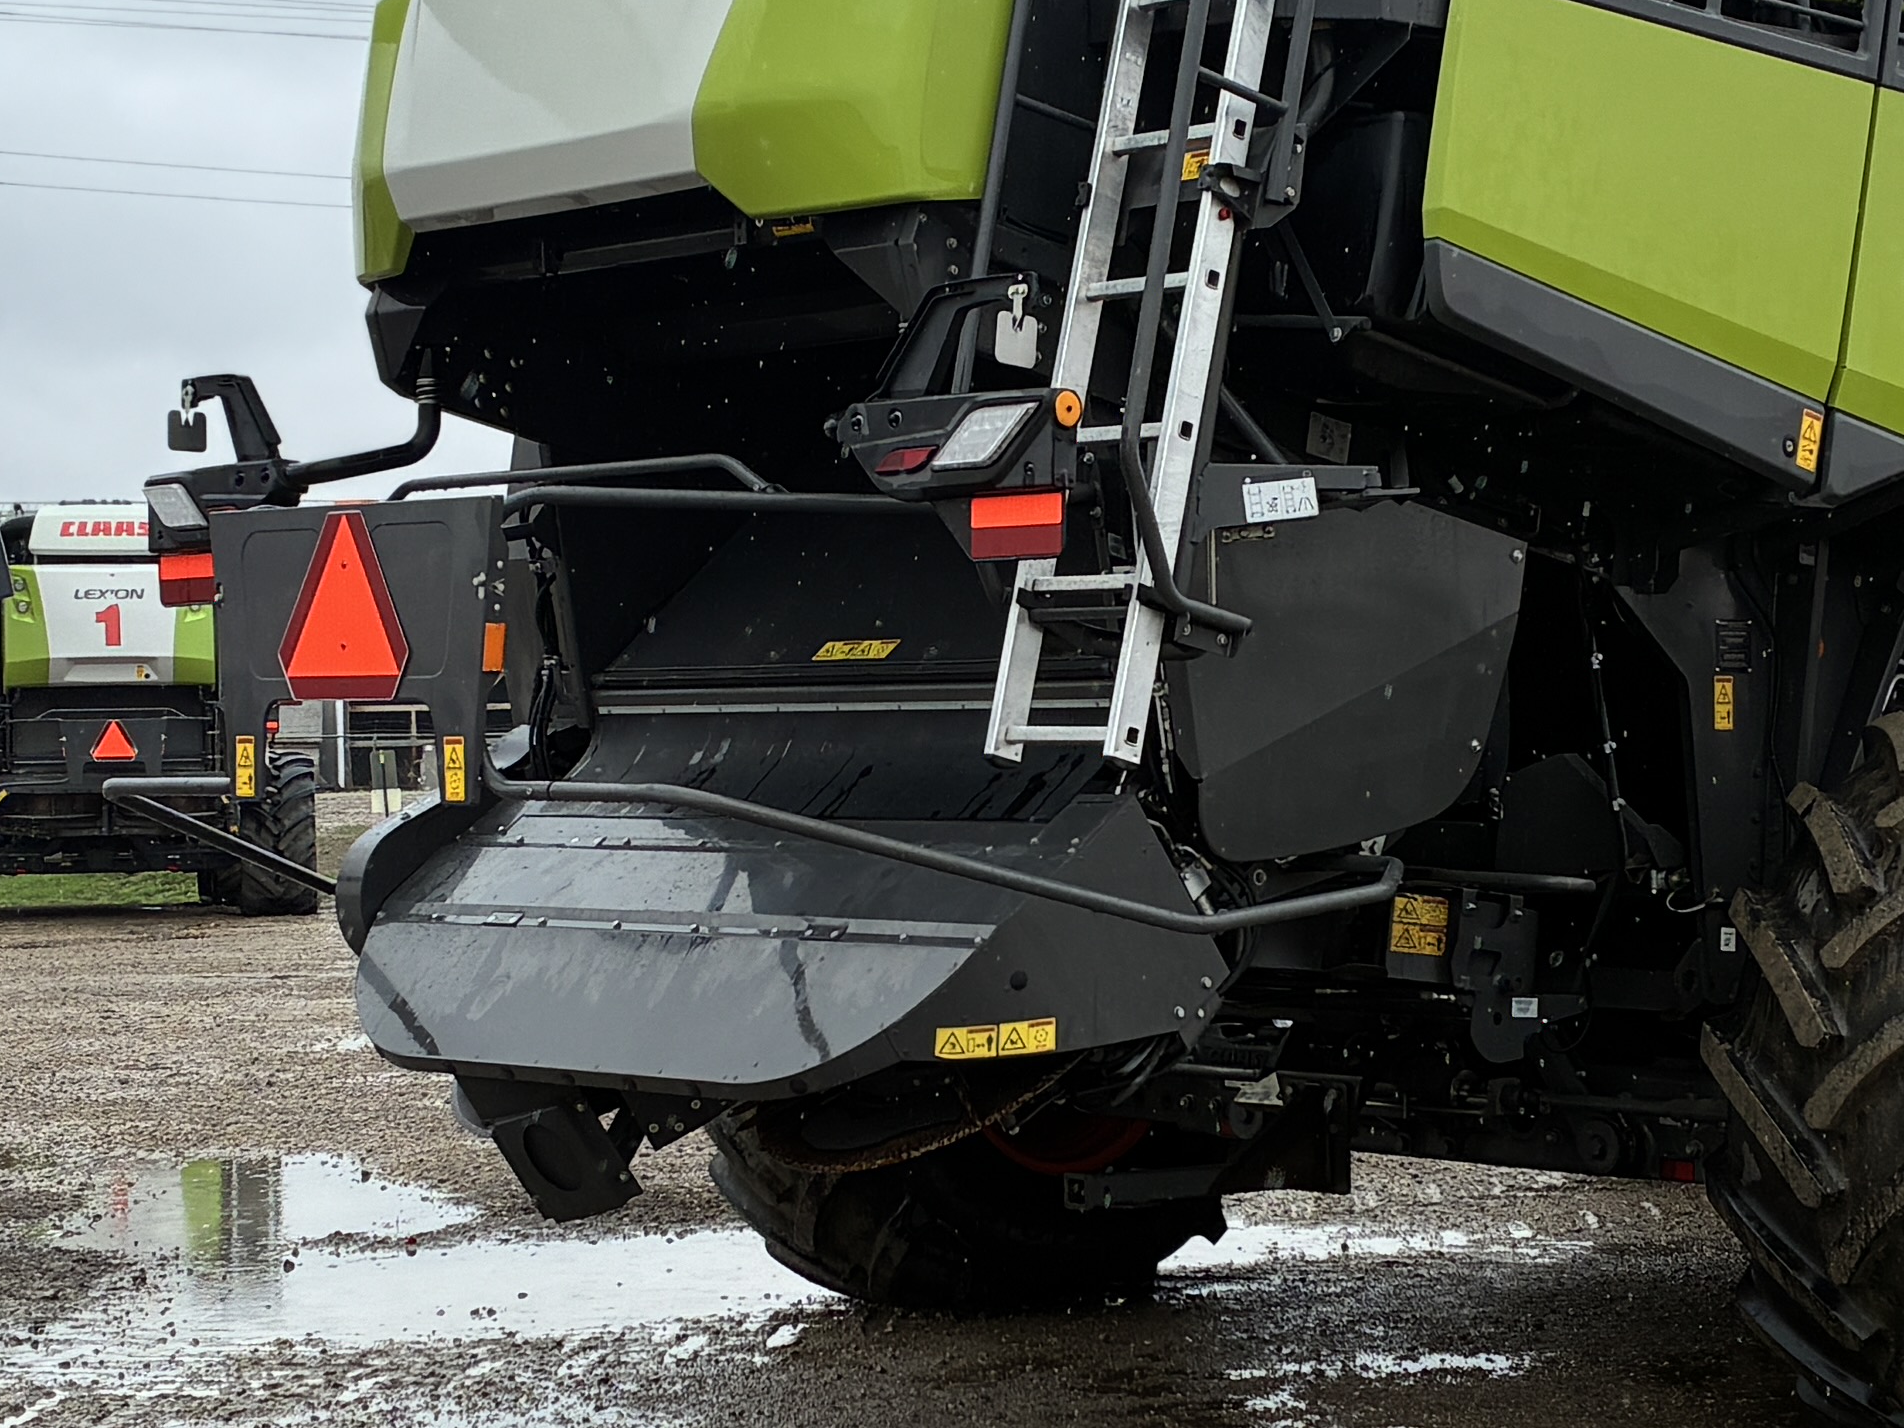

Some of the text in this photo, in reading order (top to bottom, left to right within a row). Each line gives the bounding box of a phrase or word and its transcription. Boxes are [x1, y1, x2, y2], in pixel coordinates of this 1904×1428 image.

[60, 521, 149, 537] CLAAS
[74, 588, 144, 600] LEXION
[95, 603, 121, 646] 1
